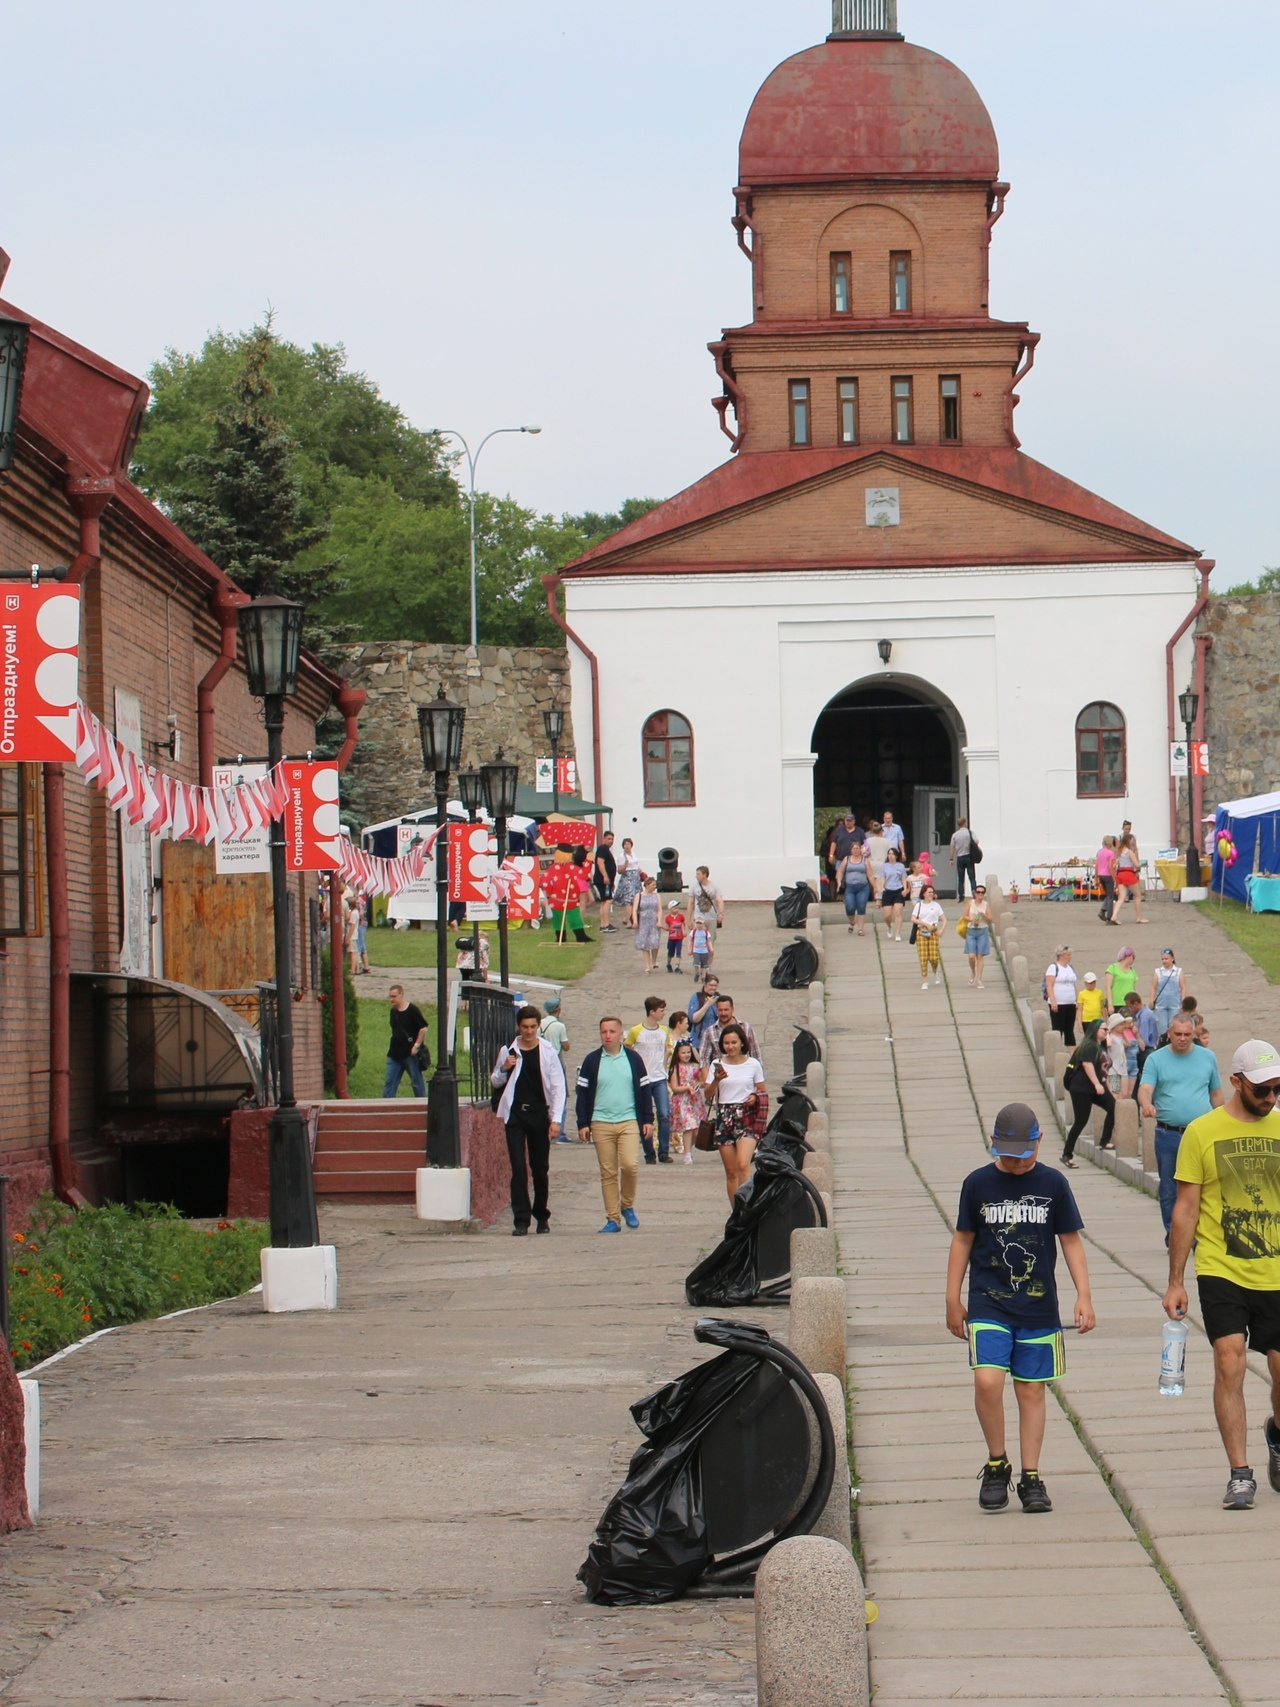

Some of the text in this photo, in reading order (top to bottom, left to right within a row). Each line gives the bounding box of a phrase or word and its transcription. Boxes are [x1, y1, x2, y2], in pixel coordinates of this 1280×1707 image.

[0, 624, 20, 754] Отпразднуем!
[292, 787, 305, 867] Отпразднуем!
[222, 846, 257, 854] крепость
[222, 854, 260, 862] характера
[453, 841, 463, 899] Отпразднуем!
[1232, 1137, 1274, 1154] TERMIT
[1243, 1158, 1267, 1170] STAY
[984, 1205, 1050, 1224] ADVENTURE
